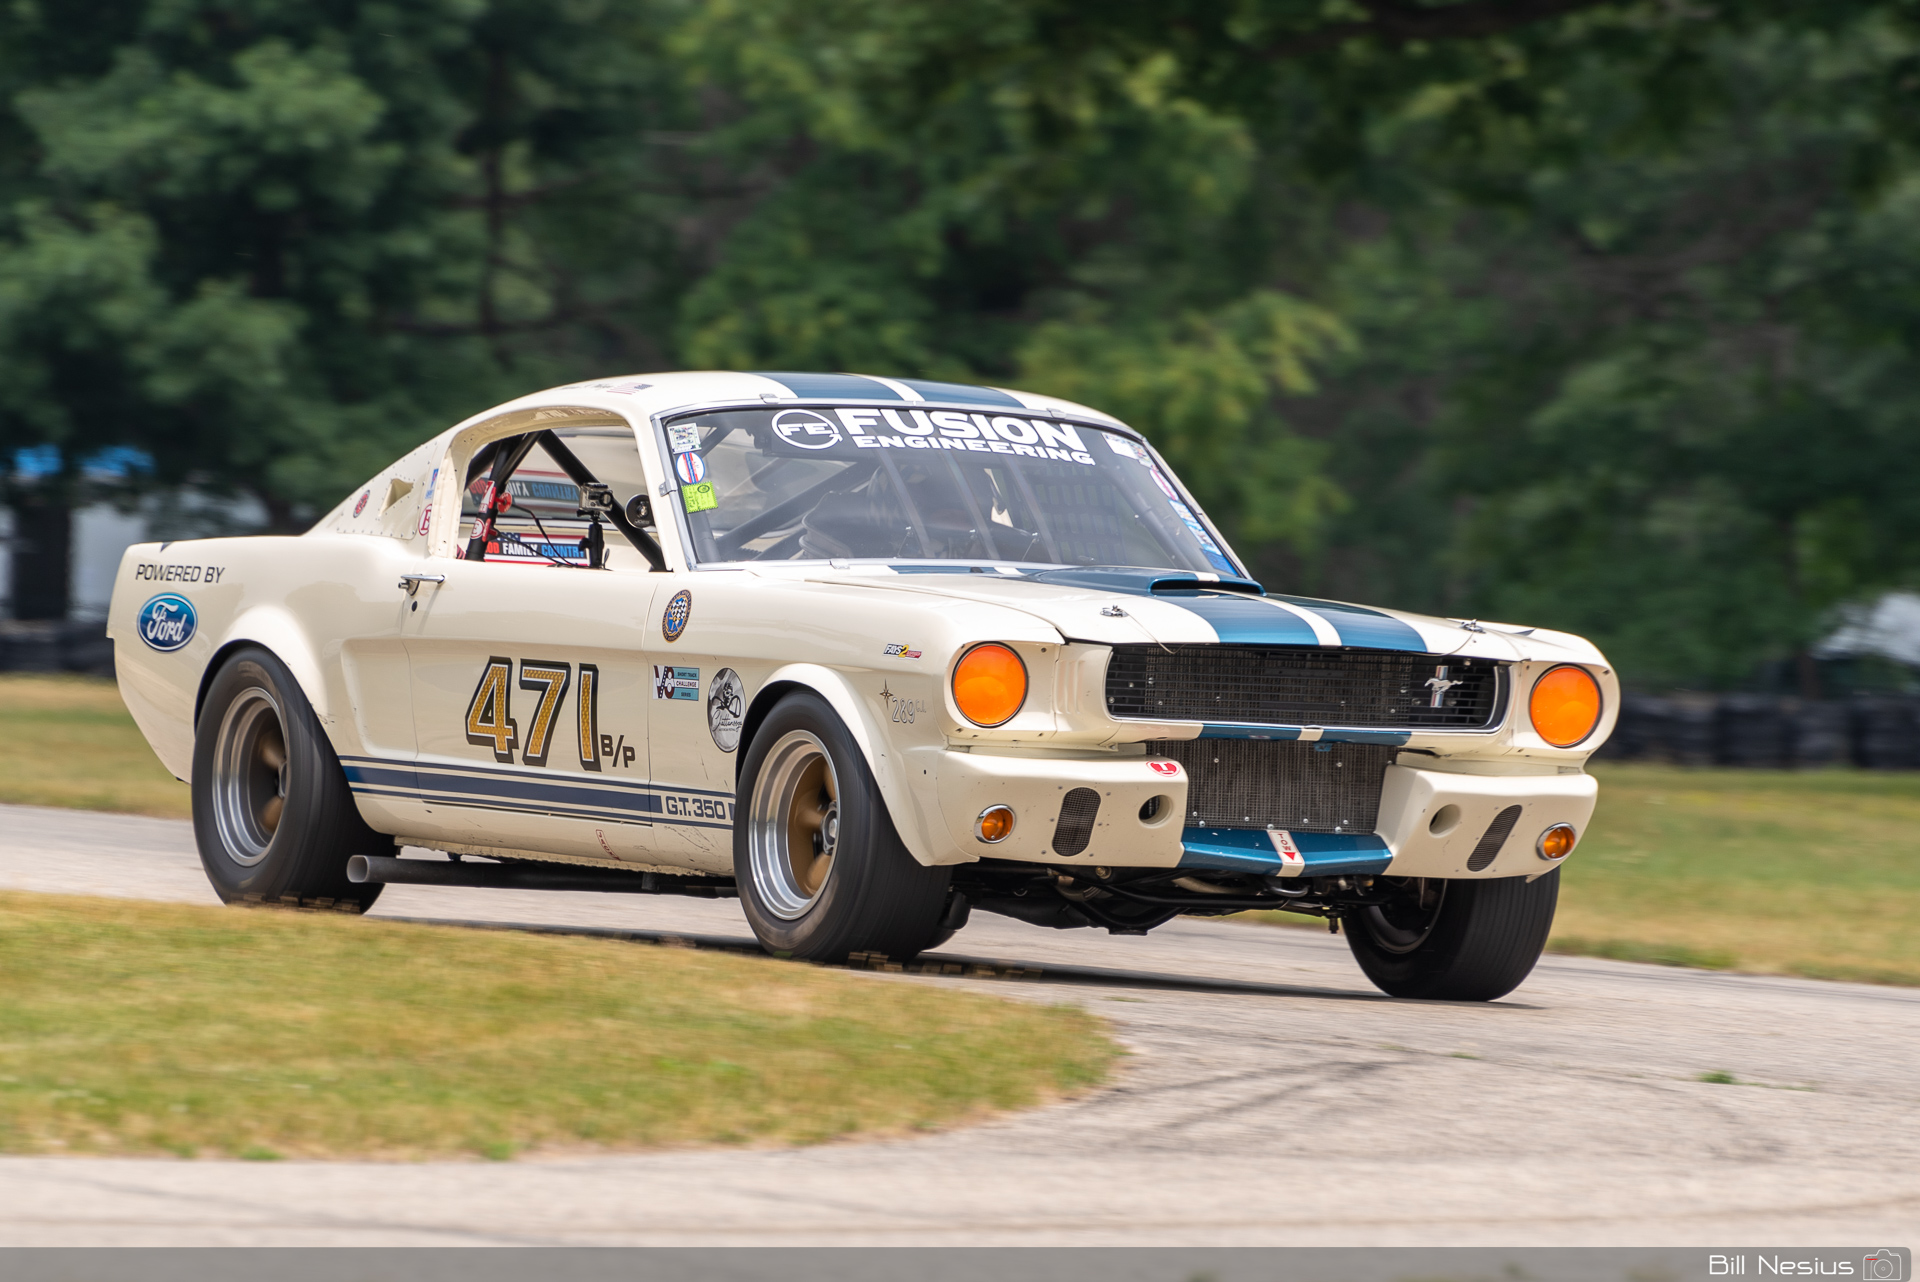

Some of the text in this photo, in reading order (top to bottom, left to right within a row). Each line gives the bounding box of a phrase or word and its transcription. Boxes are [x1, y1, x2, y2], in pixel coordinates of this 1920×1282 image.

[777, 422, 831, 437] FE
[834, 408, 1088, 452] FUSION
[852, 435, 1096, 466] ENGINEERING
[502, 542, 538, 556] FAMILY
[135, 564, 226, 584] POWERED BY
[146, 601, 188, 642] Ford
[653, 665, 675, 700] V8
[464, 655, 602, 772] 471
[891, 697, 916, 724] 289
[600, 734, 636, 768] B/P
[665, 795, 726, 820] G.T.350
[1277, 833, 1292, 851] TOW
